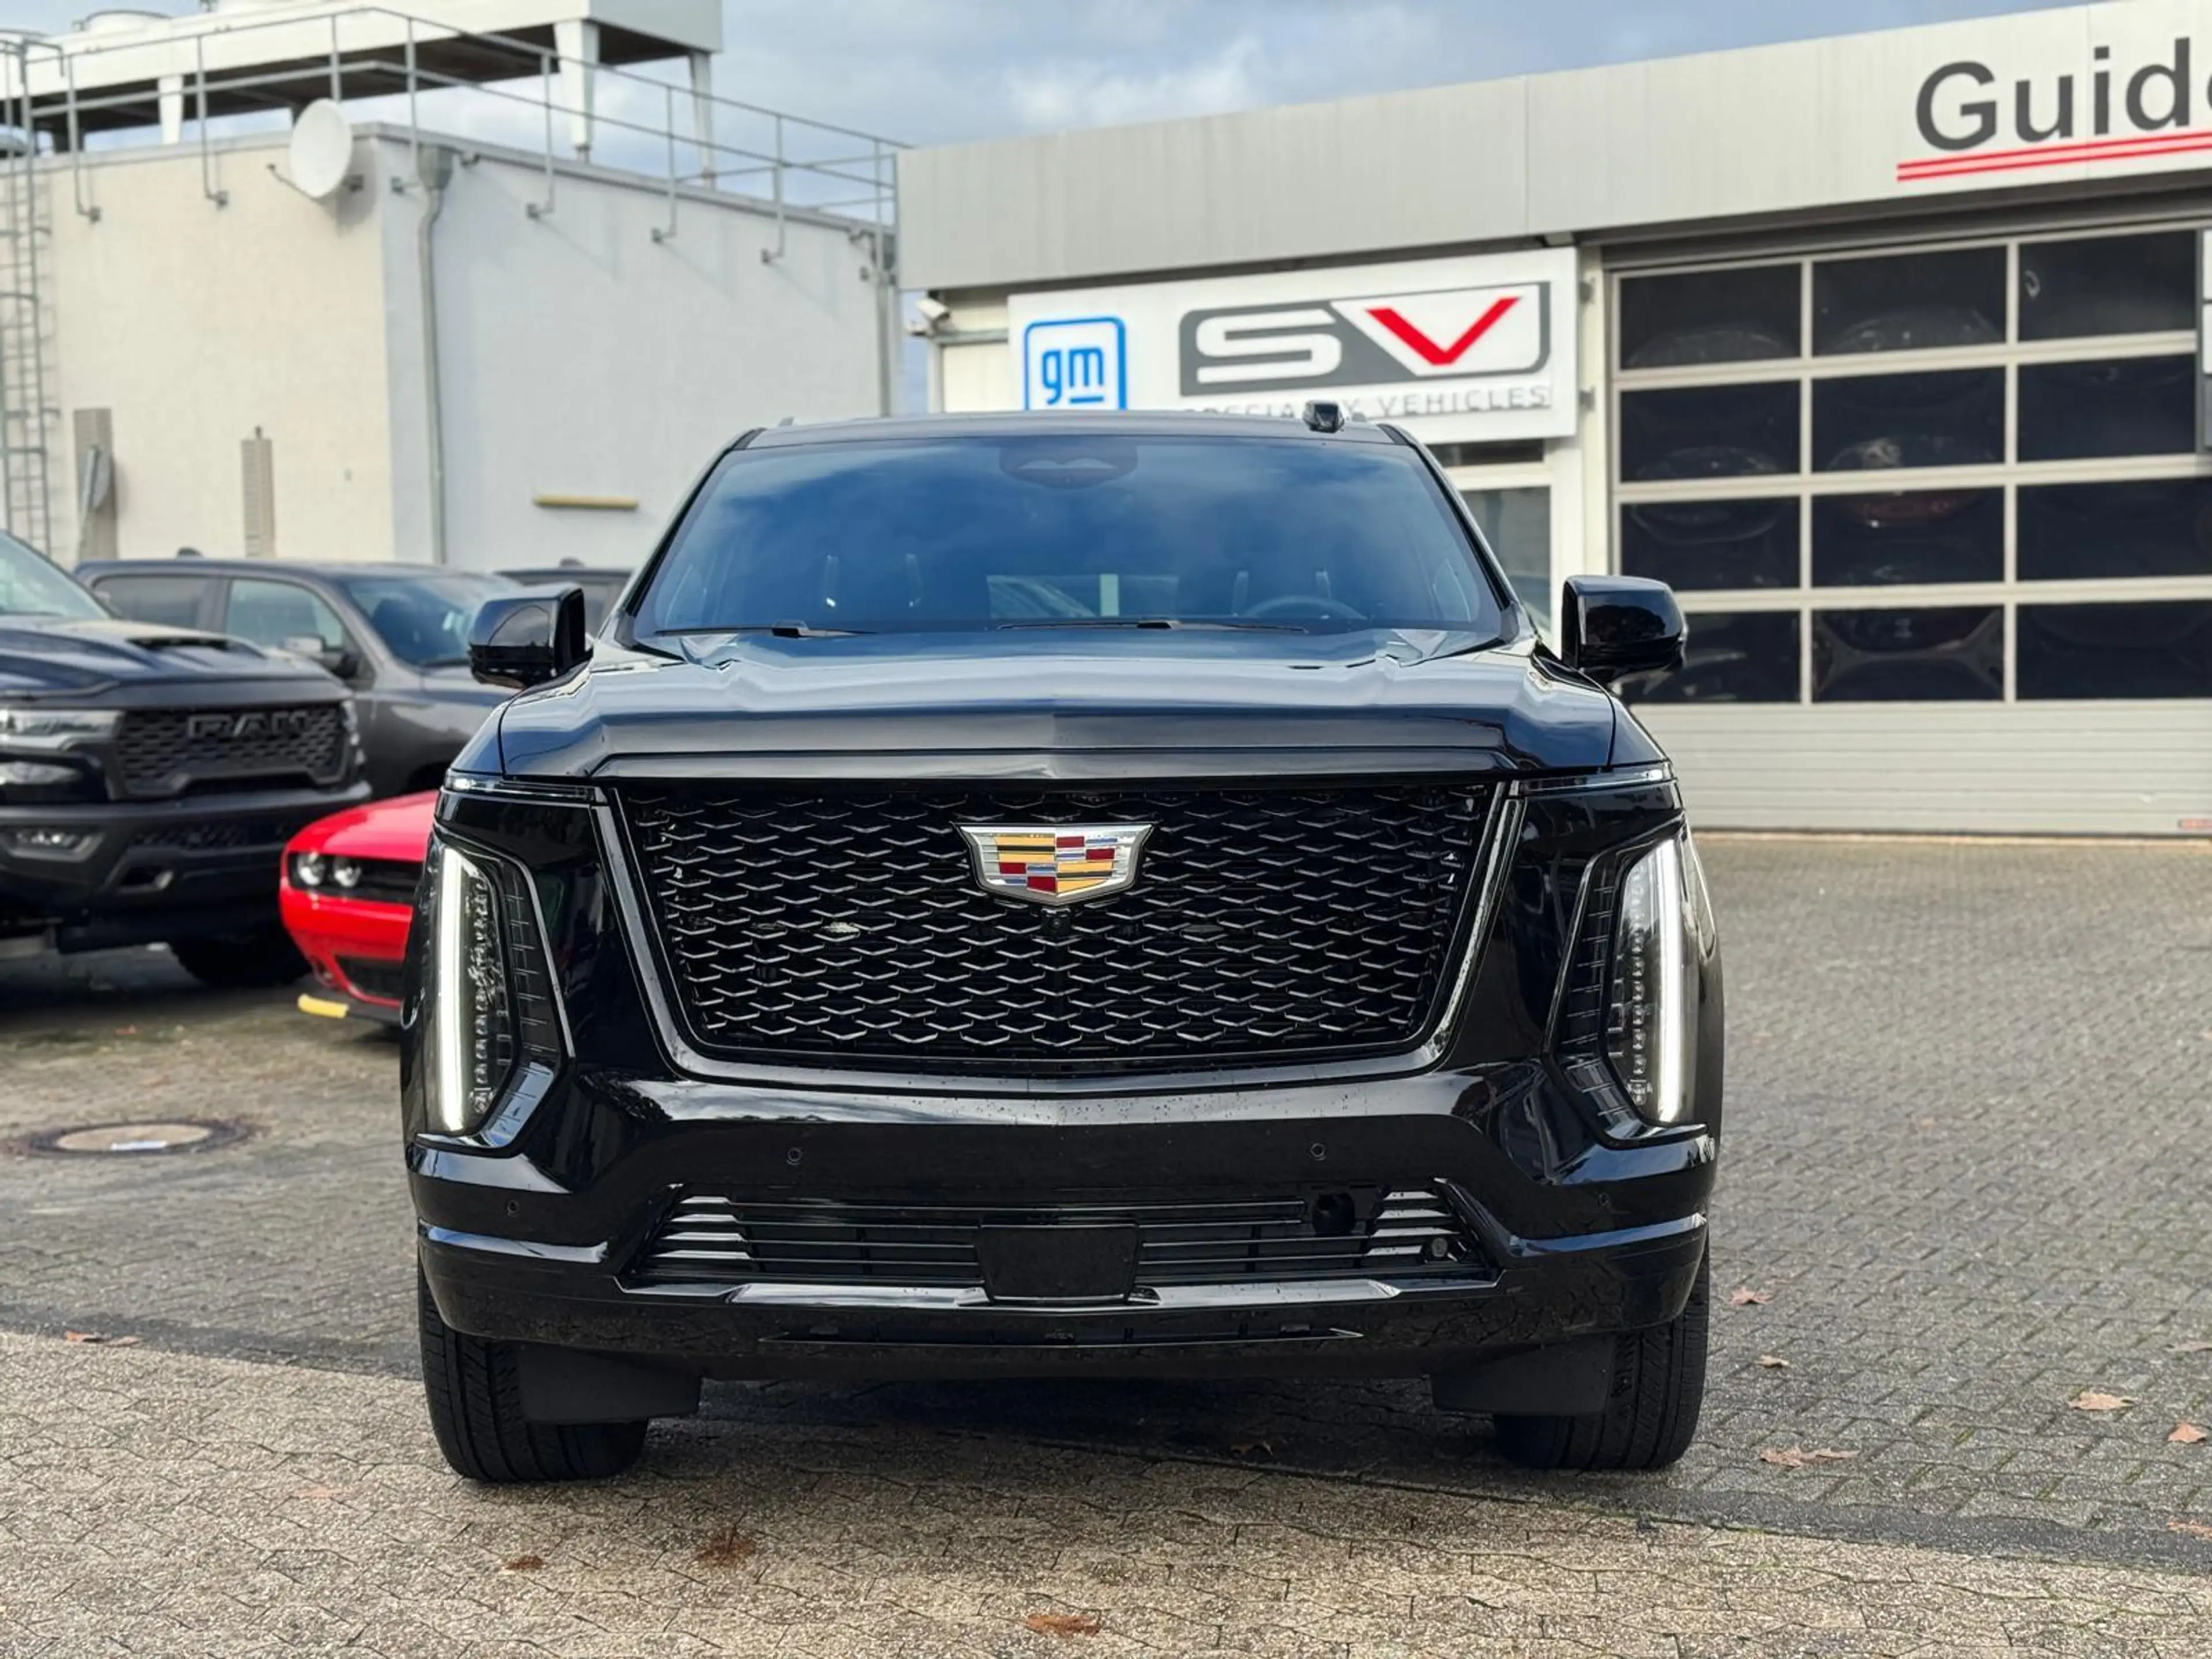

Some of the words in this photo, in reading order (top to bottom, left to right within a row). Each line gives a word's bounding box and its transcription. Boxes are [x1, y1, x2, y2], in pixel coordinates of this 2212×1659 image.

[1915, 36, 2212, 151] Guid
[1041, 347, 1104, 404] gm
[1377, 385, 1551, 418] VEHICLES
[187, 710, 309, 739] RAM
